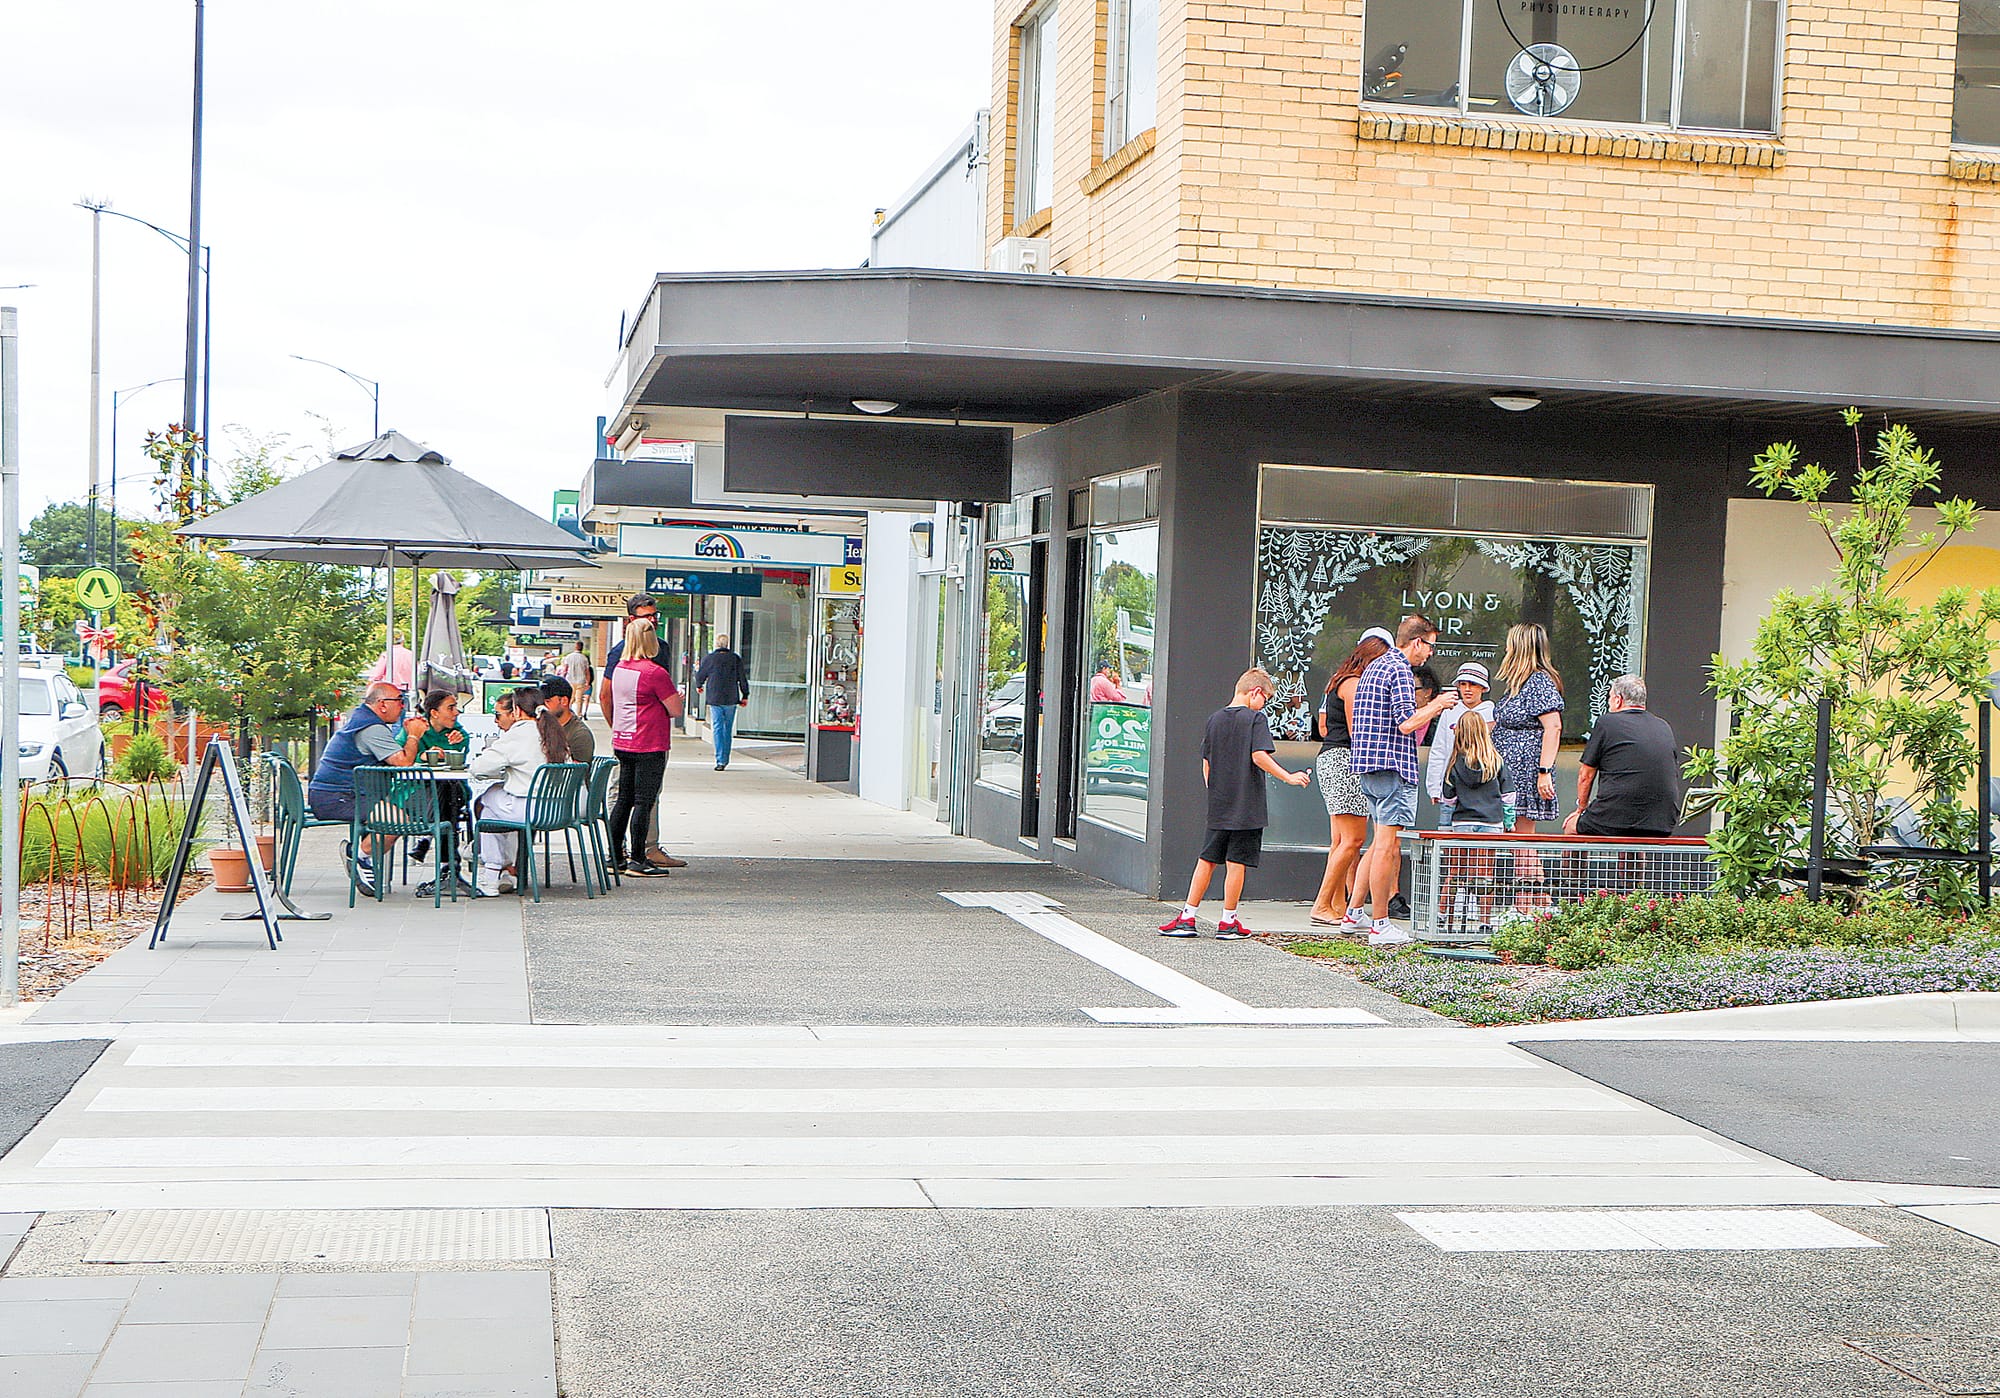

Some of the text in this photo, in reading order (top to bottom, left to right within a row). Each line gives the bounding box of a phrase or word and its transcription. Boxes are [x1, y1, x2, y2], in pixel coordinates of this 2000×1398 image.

[1521, 1, 1630, 19] PHYSIOTHERAPY
[695, 542, 728, 557] Lott
[650, 577, 684, 590] ANZ
[1402, 589, 1501, 611] LYON &
[1437, 649, 1461, 657] EATERY
